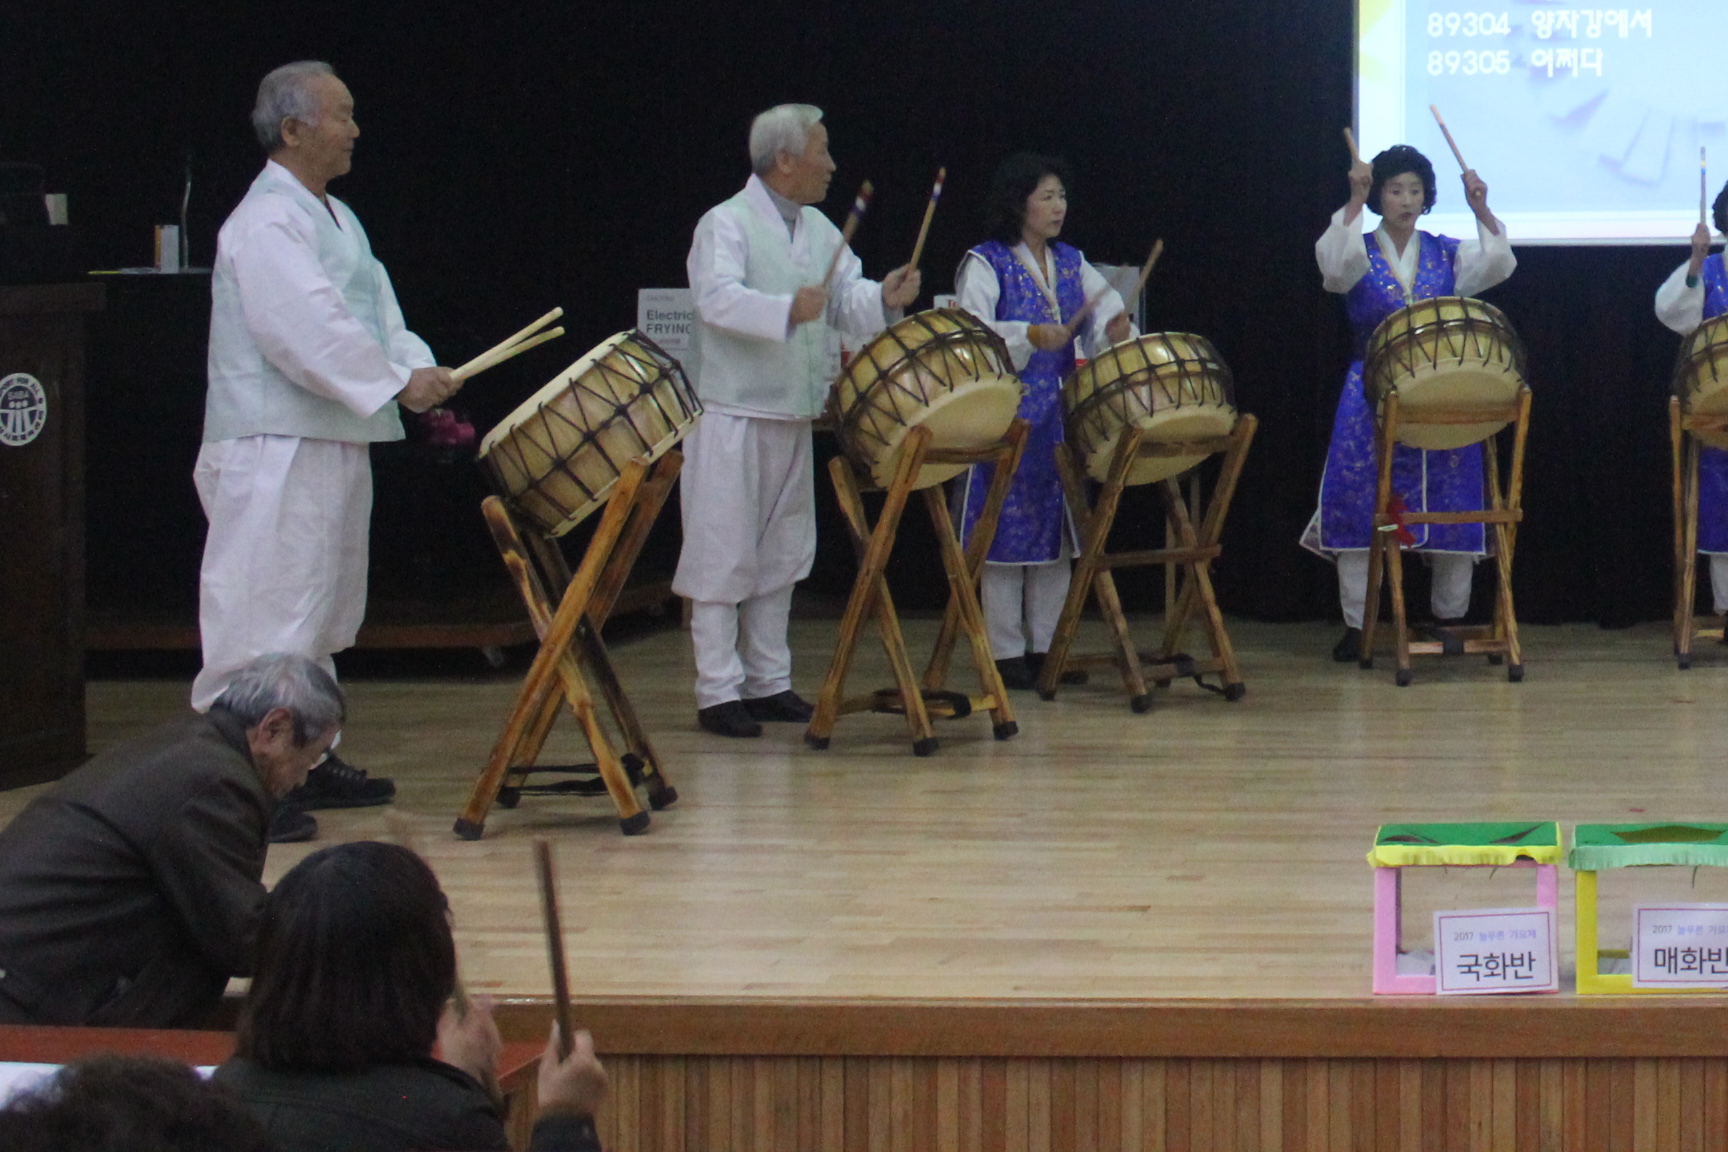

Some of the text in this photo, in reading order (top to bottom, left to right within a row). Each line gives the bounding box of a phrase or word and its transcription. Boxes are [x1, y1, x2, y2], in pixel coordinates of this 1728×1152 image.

[1427, 12, 1511, 37] 89304
[1530, 9, 1653, 39] 양자강에서
[1427, 50, 1511, 76] 89305
[1530, 48, 1603, 78] 어쩌다
[646, 310, 695, 321] Electric
[1454, 931, 1474, 941] 2017
[1652, 925, 1673, 934] 2017
[1456, 951, 1537, 982] 국화반
